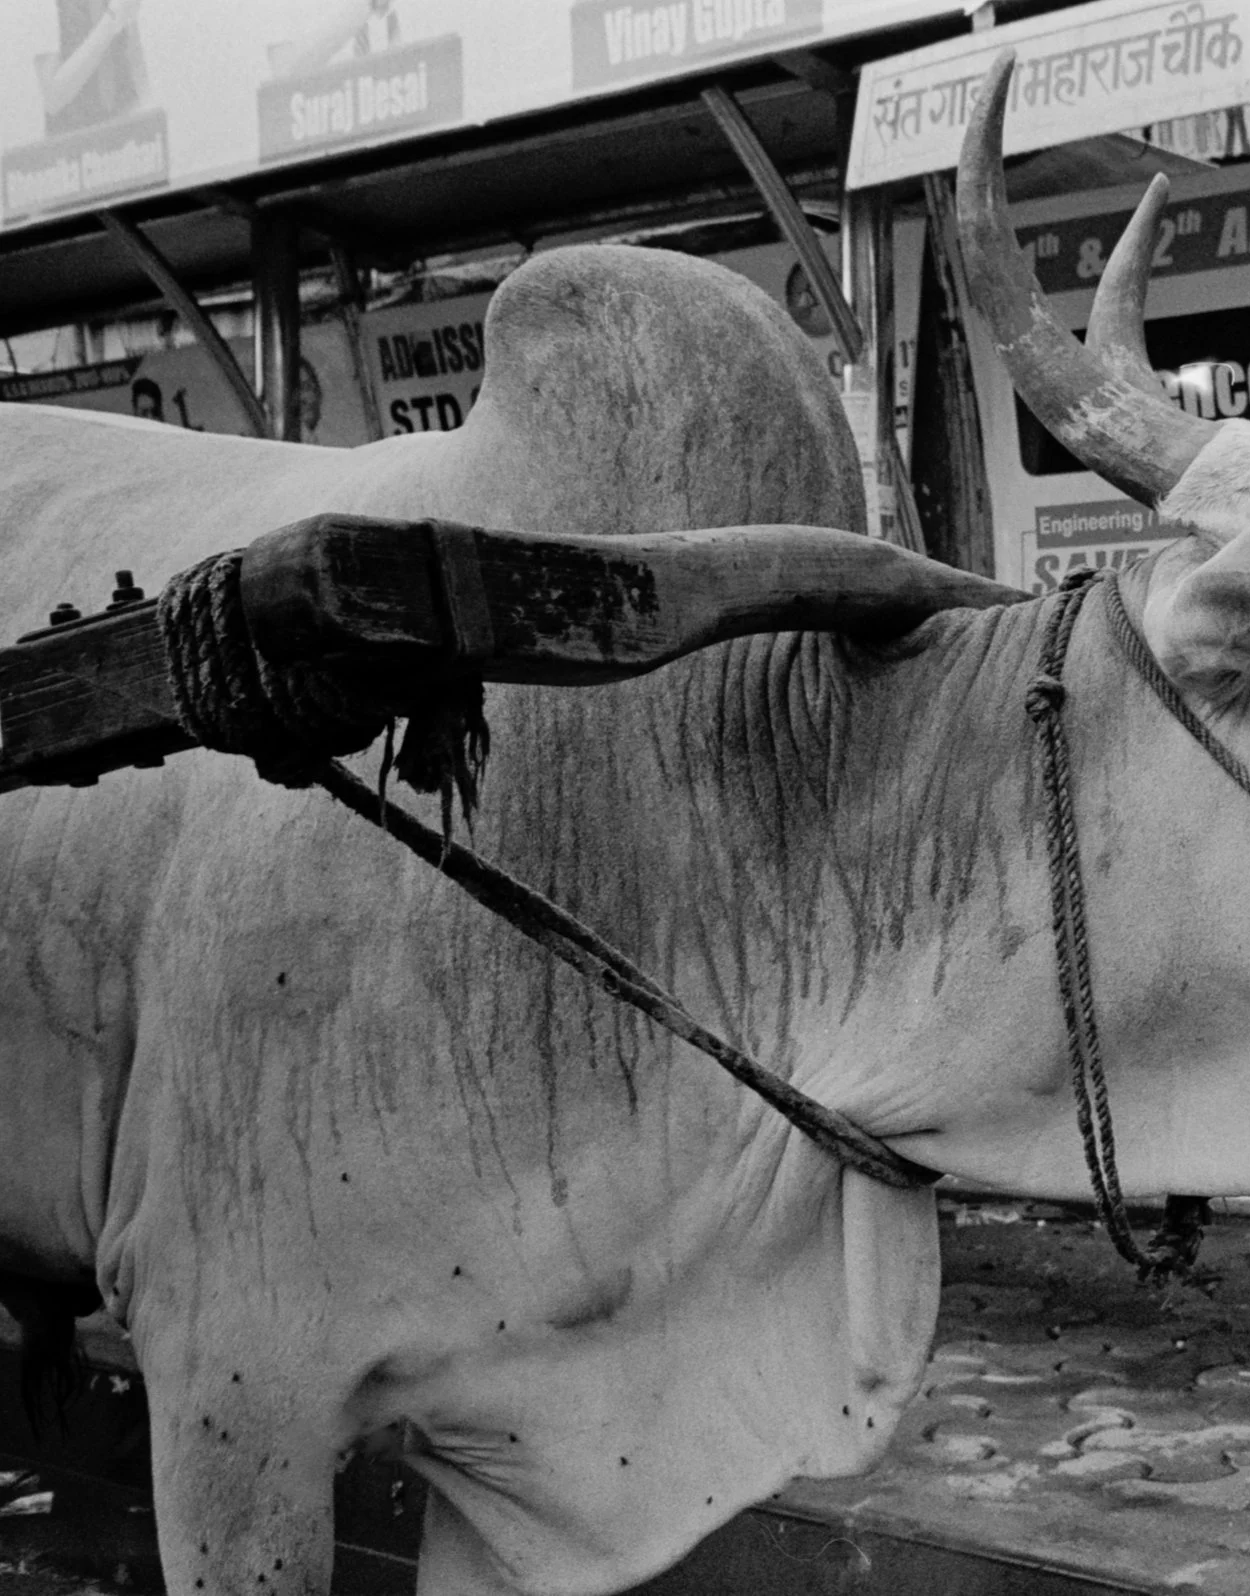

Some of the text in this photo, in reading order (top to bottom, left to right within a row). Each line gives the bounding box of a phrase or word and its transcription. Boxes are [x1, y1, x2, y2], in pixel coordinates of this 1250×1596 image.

[604, 4, 687, 66] Vinay
[1022, 31, 1162, 106] महाराज
[291, 61, 428, 141] Suraj Desai
[1151, 209, 1202, 268] 2th
[1039, 510, 1143, 538] Engineering
